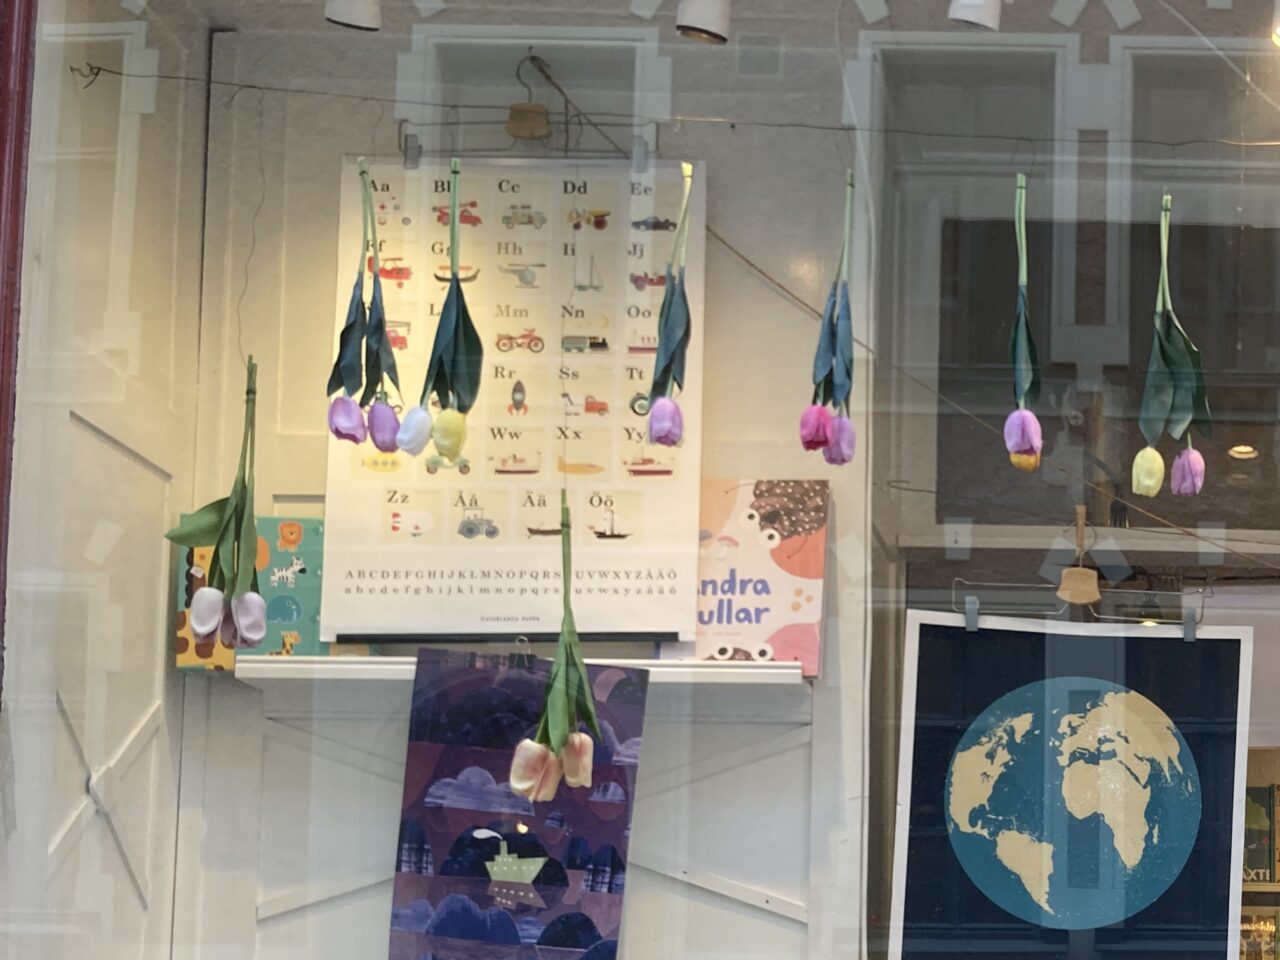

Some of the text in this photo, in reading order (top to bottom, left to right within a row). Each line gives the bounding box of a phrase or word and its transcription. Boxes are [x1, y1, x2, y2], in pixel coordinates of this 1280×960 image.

[498, 179, 521, 194] Cc
[562, 179, 589, 195] Dd
[629, 182, 653, 196] Ee
[496, 242, 523, 256] Hh
[562, 243, 577, 257] Ii
[627, 243, 645, 259] Jj
[495, 304, 530, 318] Mm
[560, 304, 585, 318] Nn
[627, 305, 652, 319] Oo
[493, 365, 517, 380] Rr
[559, 366, 580, 381] Ss
[626, 367, 645, 381] Tt
[490, 426, 522, 441] Ww
[556, 426, 583, 441] Xx
[623, 427, 647, 443] Yy
[387, 489, 410, 505] Zz
[453, 489, 479, 508] Åå
[522, 490, 548, 508] Ää
[589, 490, 615, 508] Öö
